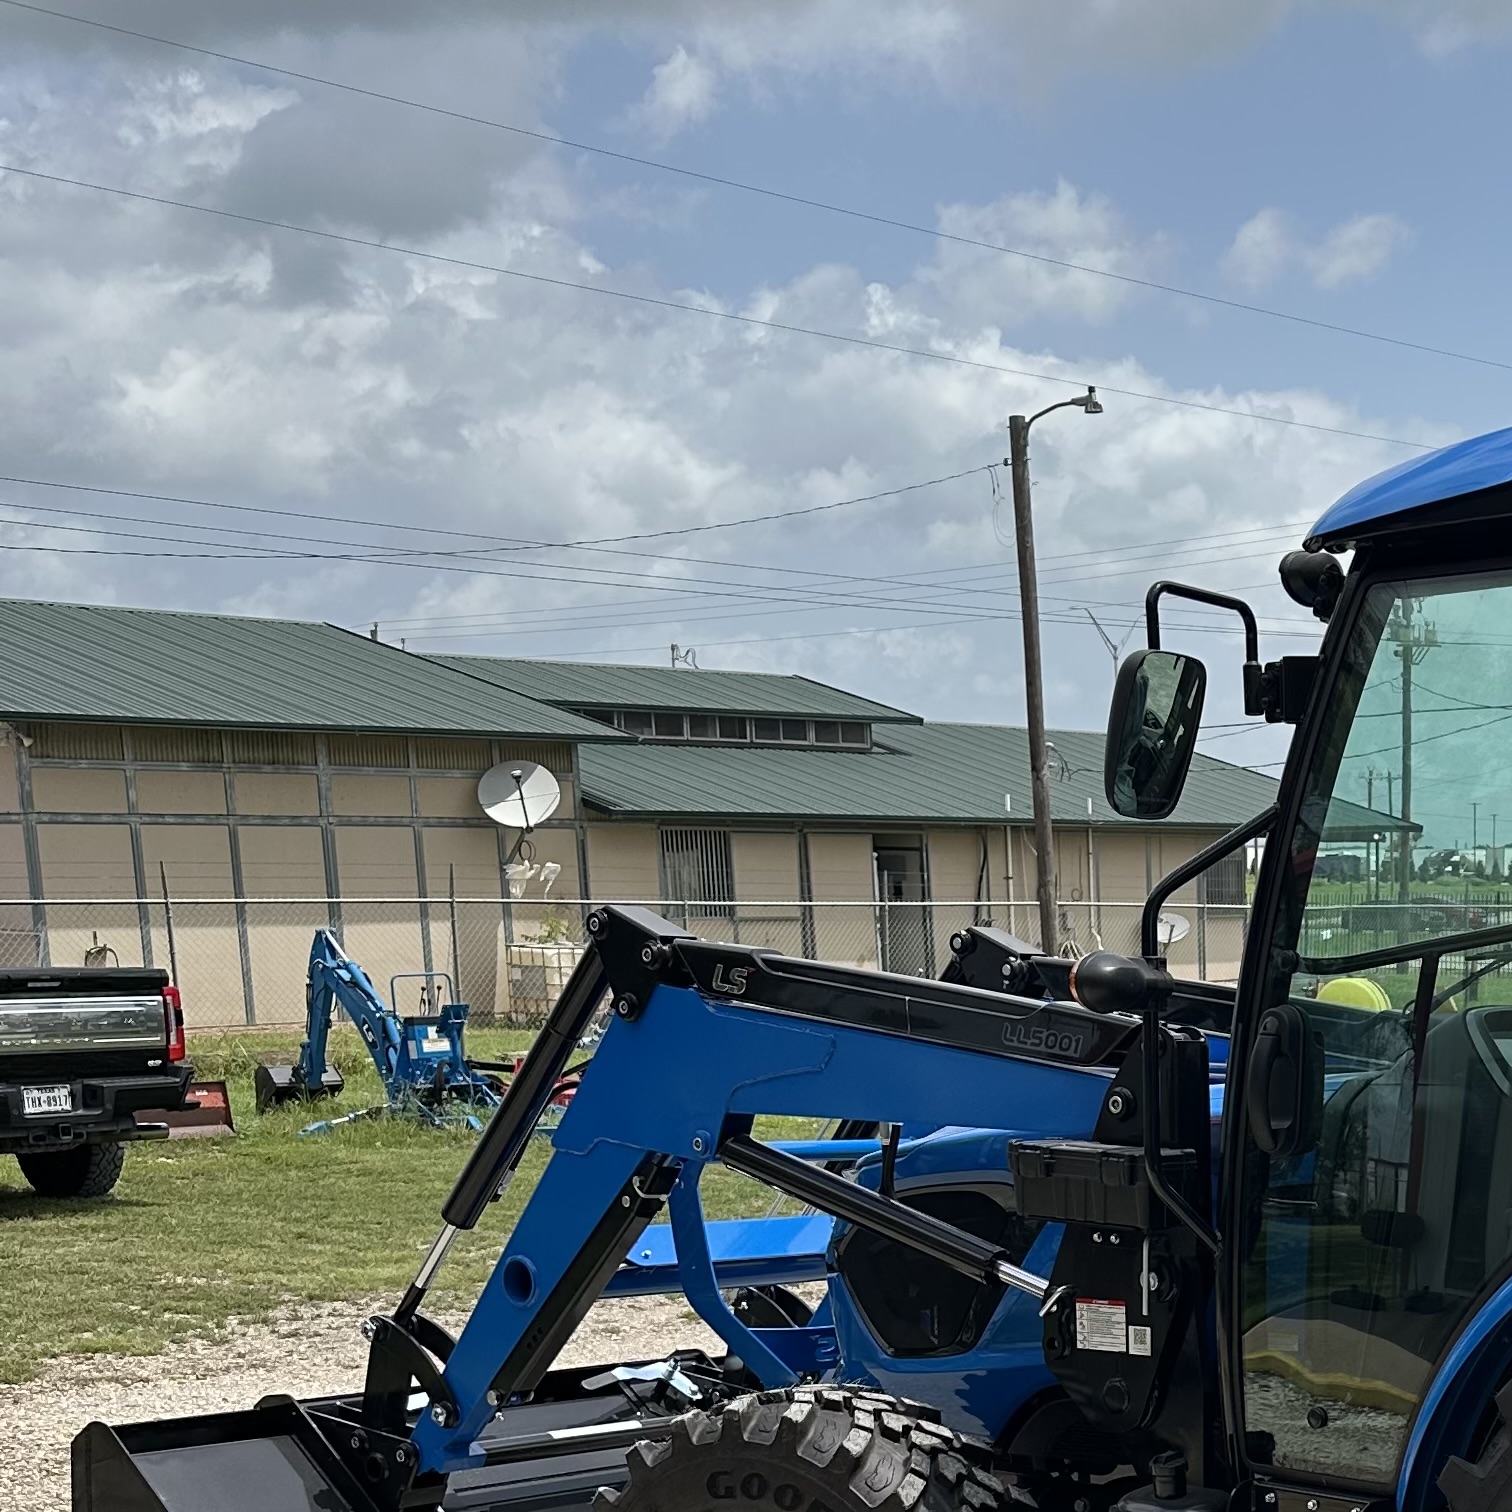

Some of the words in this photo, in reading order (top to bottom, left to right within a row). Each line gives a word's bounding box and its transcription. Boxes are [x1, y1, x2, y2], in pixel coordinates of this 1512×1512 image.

[711, 963, 748, 995] LS
[362, 1023, 375, 1043] LS
[1002, 1022, 1083, 1058] LL5001
